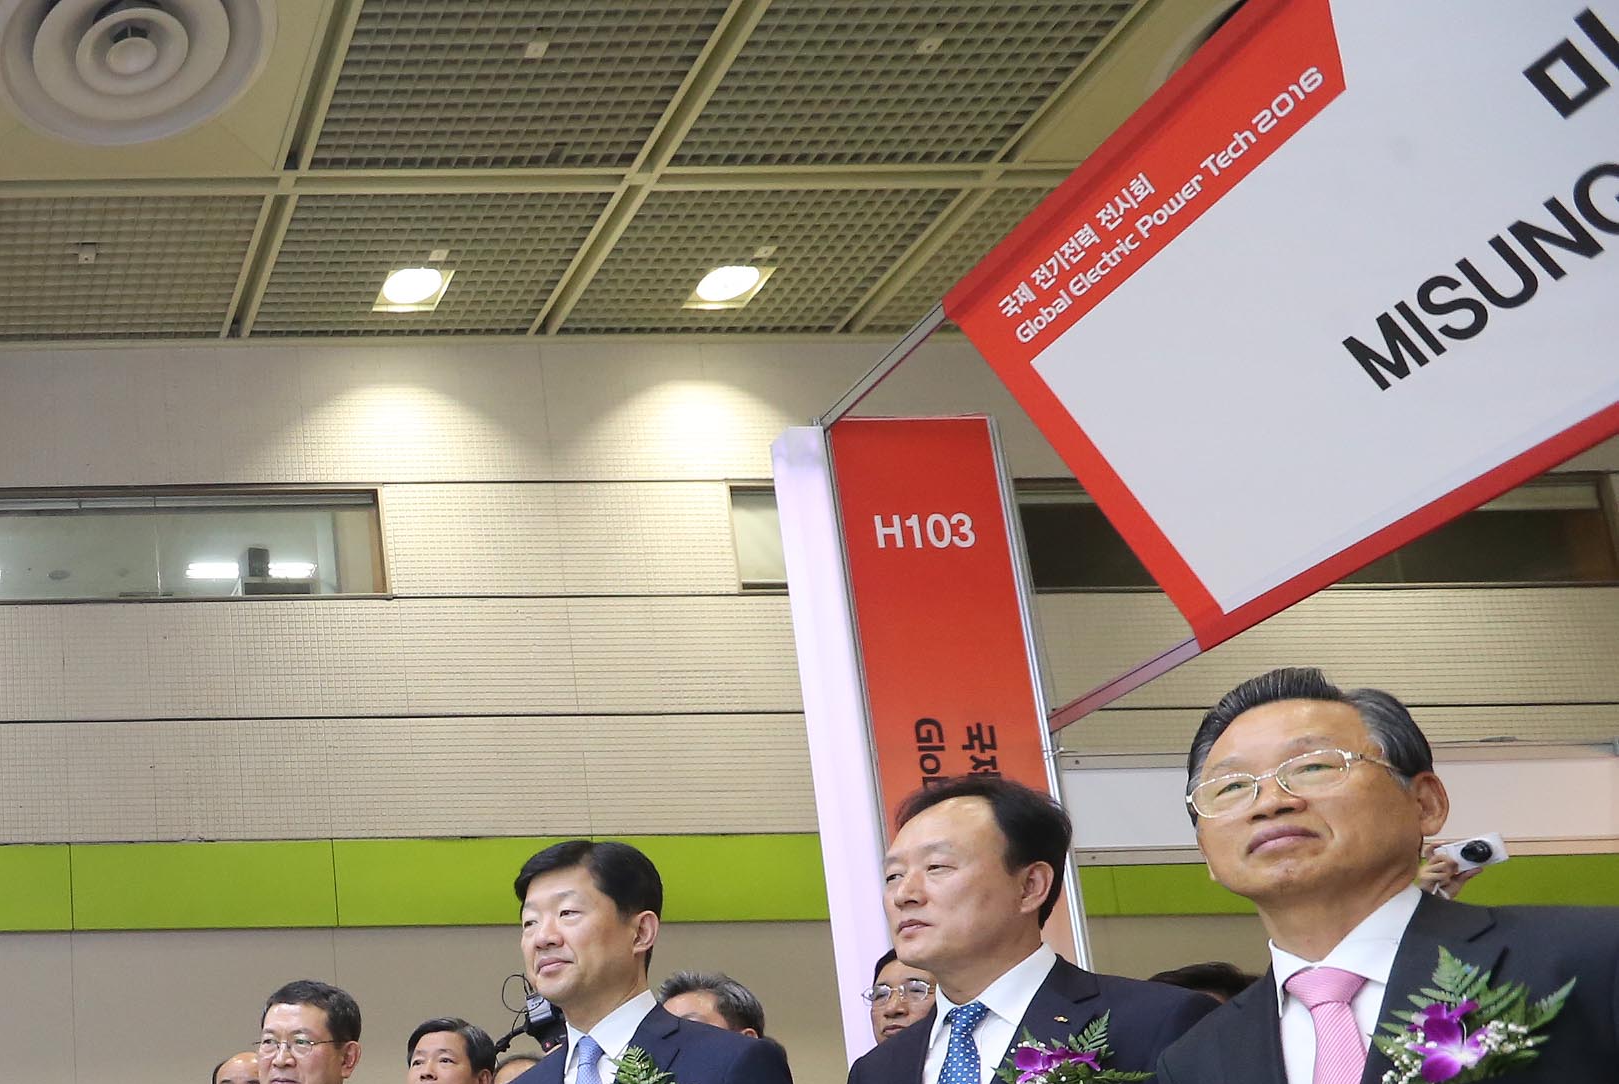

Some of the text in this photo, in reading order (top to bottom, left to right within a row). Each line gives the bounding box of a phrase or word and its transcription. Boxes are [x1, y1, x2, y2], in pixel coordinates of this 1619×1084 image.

[998, 172, 1156, 317] 국제 전기전력 전시회
[1015, 66, 1324, 343] Global Electric Power Tech 2016
[874, 512, 976, 548] H103
